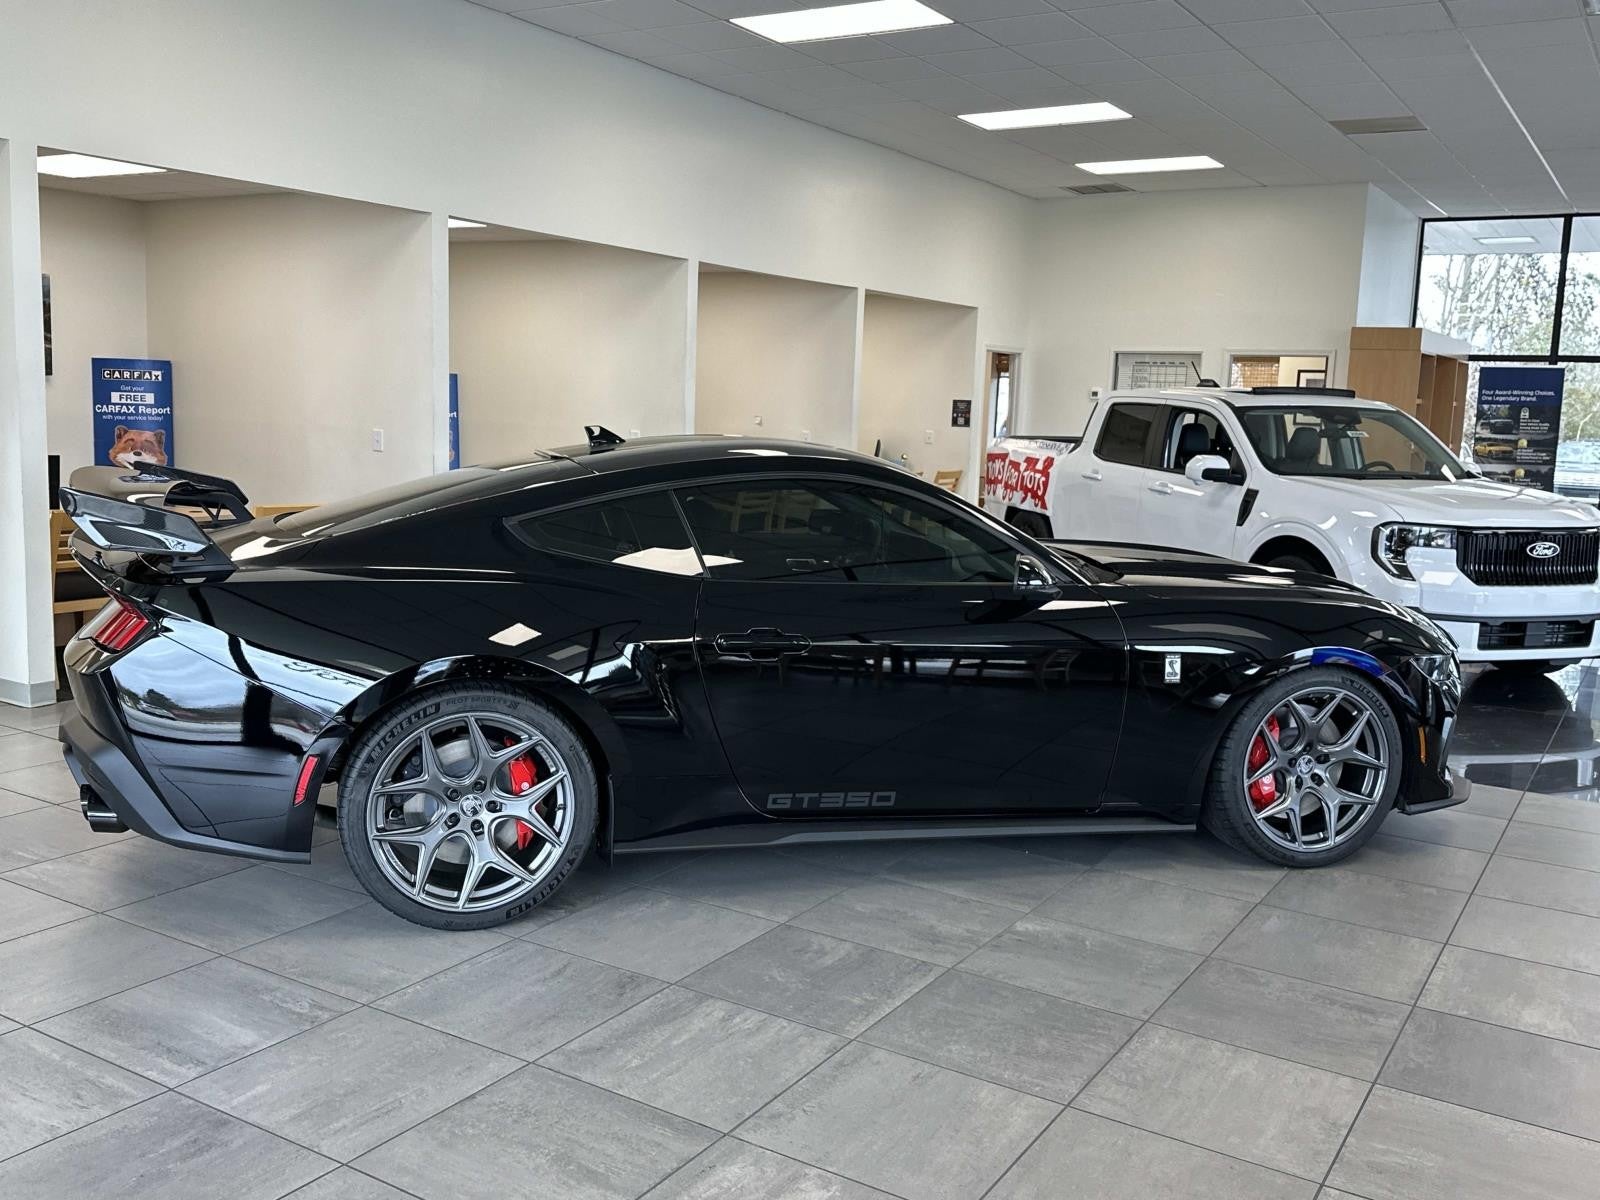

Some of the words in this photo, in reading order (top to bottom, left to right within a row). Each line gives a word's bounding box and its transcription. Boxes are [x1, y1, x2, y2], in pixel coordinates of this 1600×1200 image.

[103, 370, 161, 381] CARFAX
[118, 394, 147, 402] FREE
[95, 404, 136, 414] CARFAX
[138, 406, 171, 415] Report
[987, 460, 1005, 480] TOYS
[1005, 463, 1019, 487] FOR
[1022, 470, 1046, 496] TOTS
[370, 703, 438, 761] MICHELIN
[766, 791, 897, 809] GT350
[509, 860, 573, 918] MICHELIN
